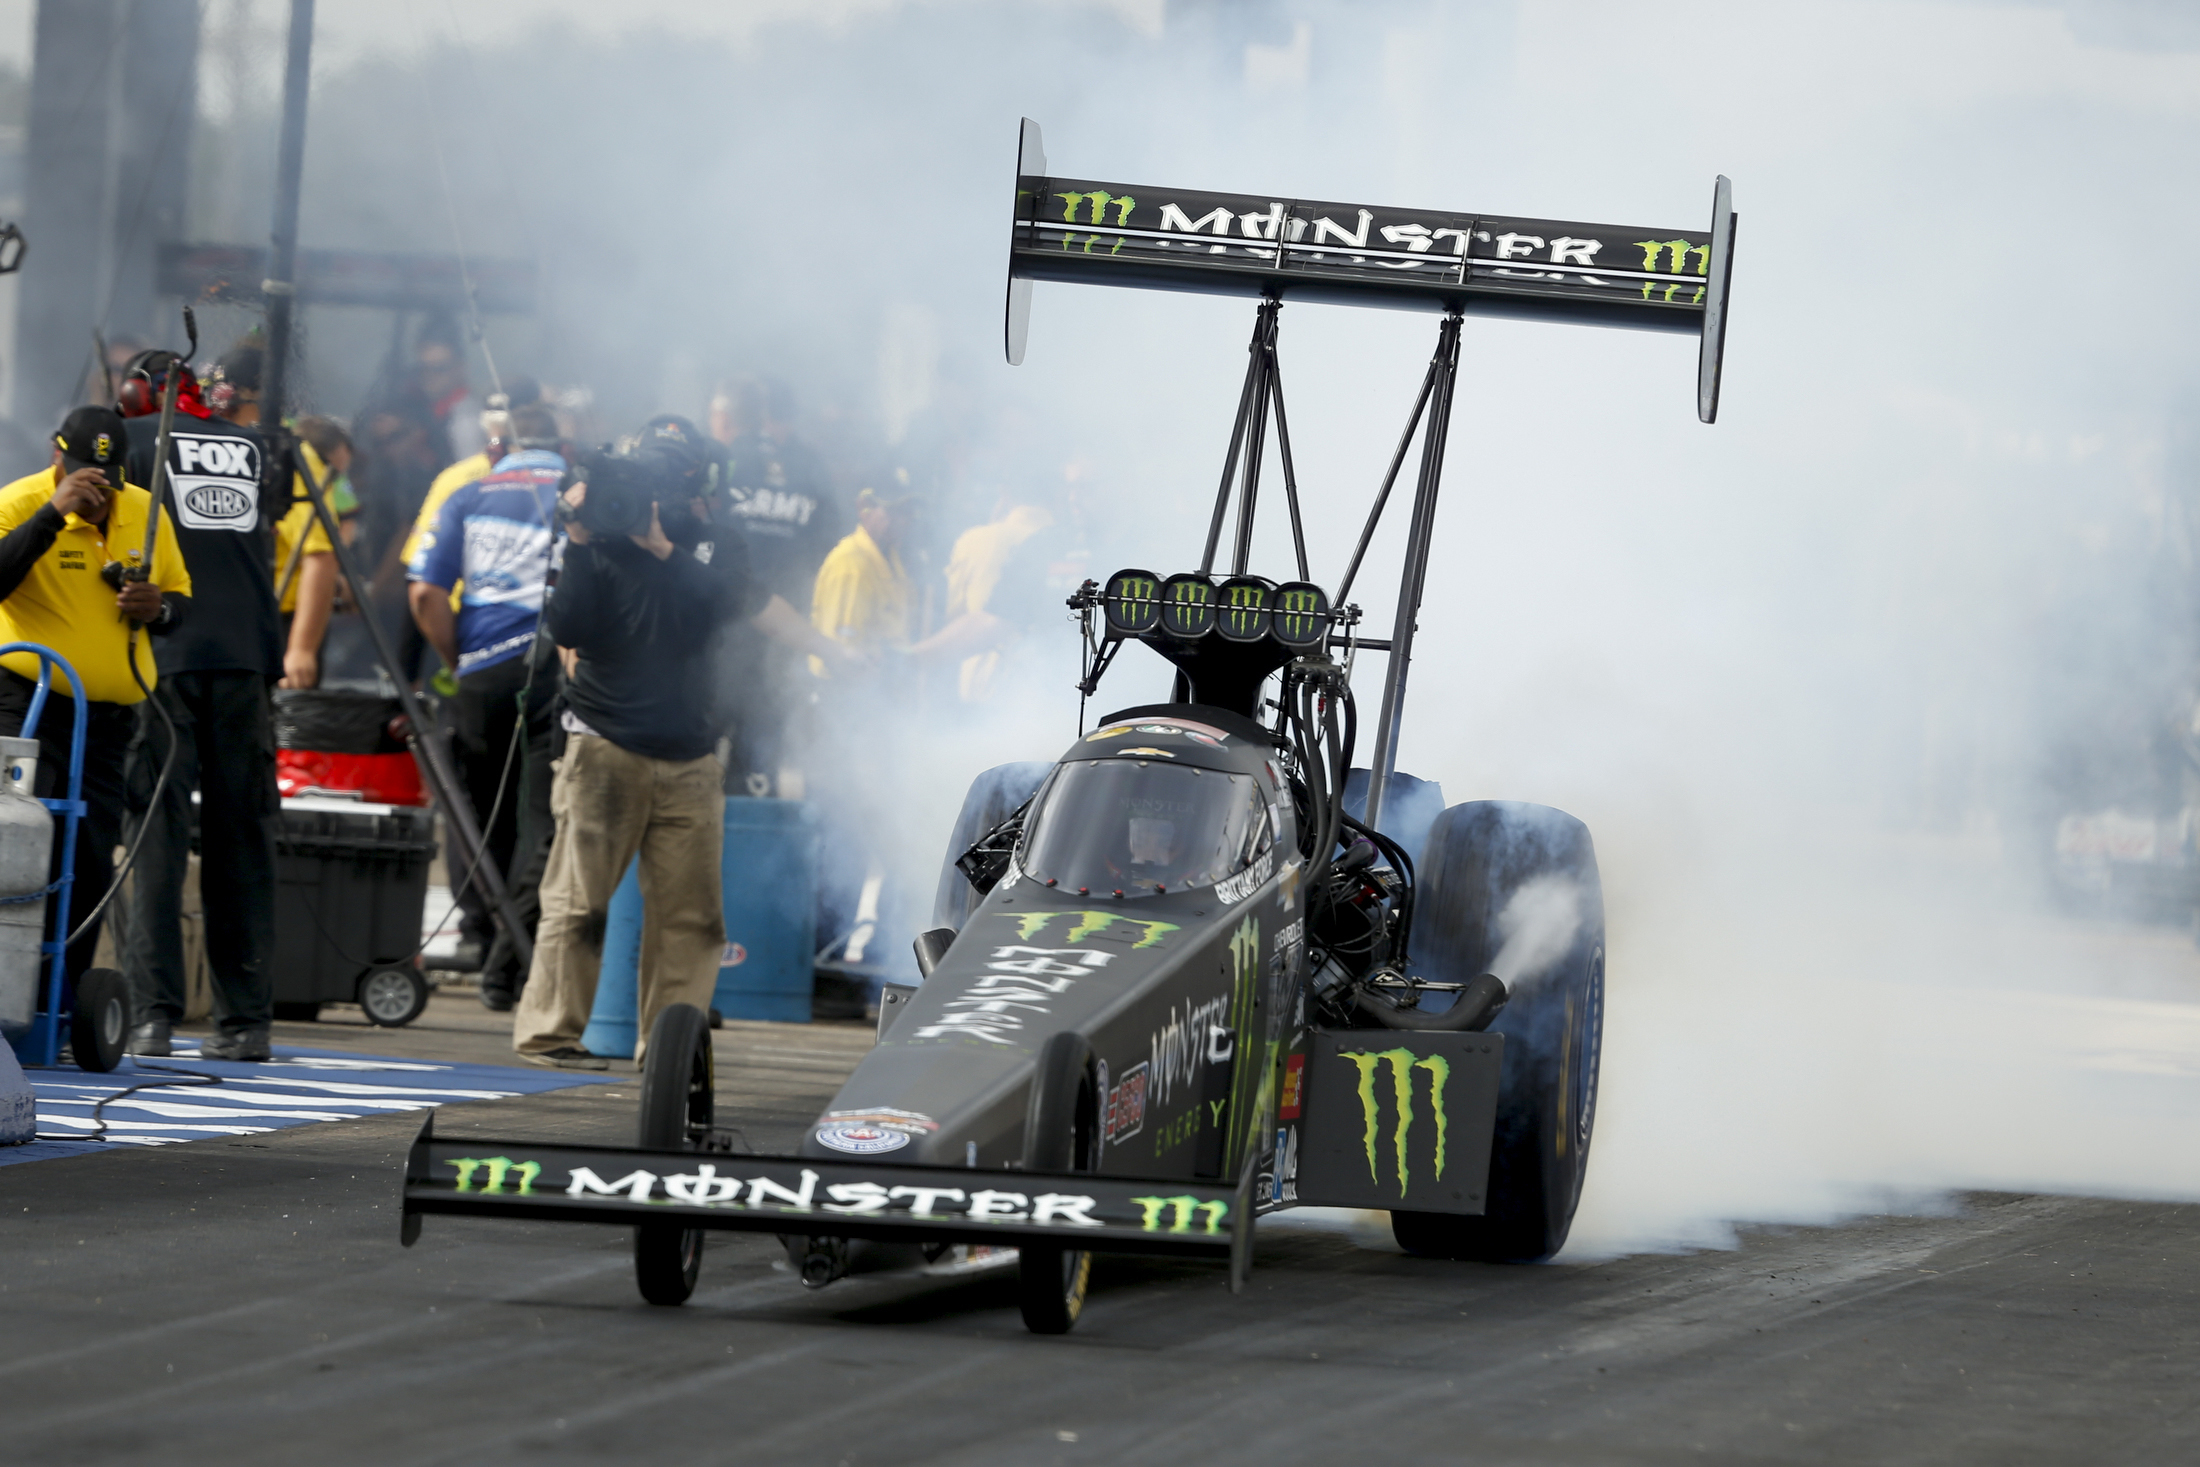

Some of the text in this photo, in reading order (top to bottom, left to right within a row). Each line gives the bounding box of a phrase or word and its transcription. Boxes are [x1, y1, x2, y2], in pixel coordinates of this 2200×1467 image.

[1158, 202, 1611, 287] MONSTER
[176, 438, 253, 478] FOX
[193, 488, 244, 519] NHRA
[566, 1164, 1105, 1228] MONSTER
